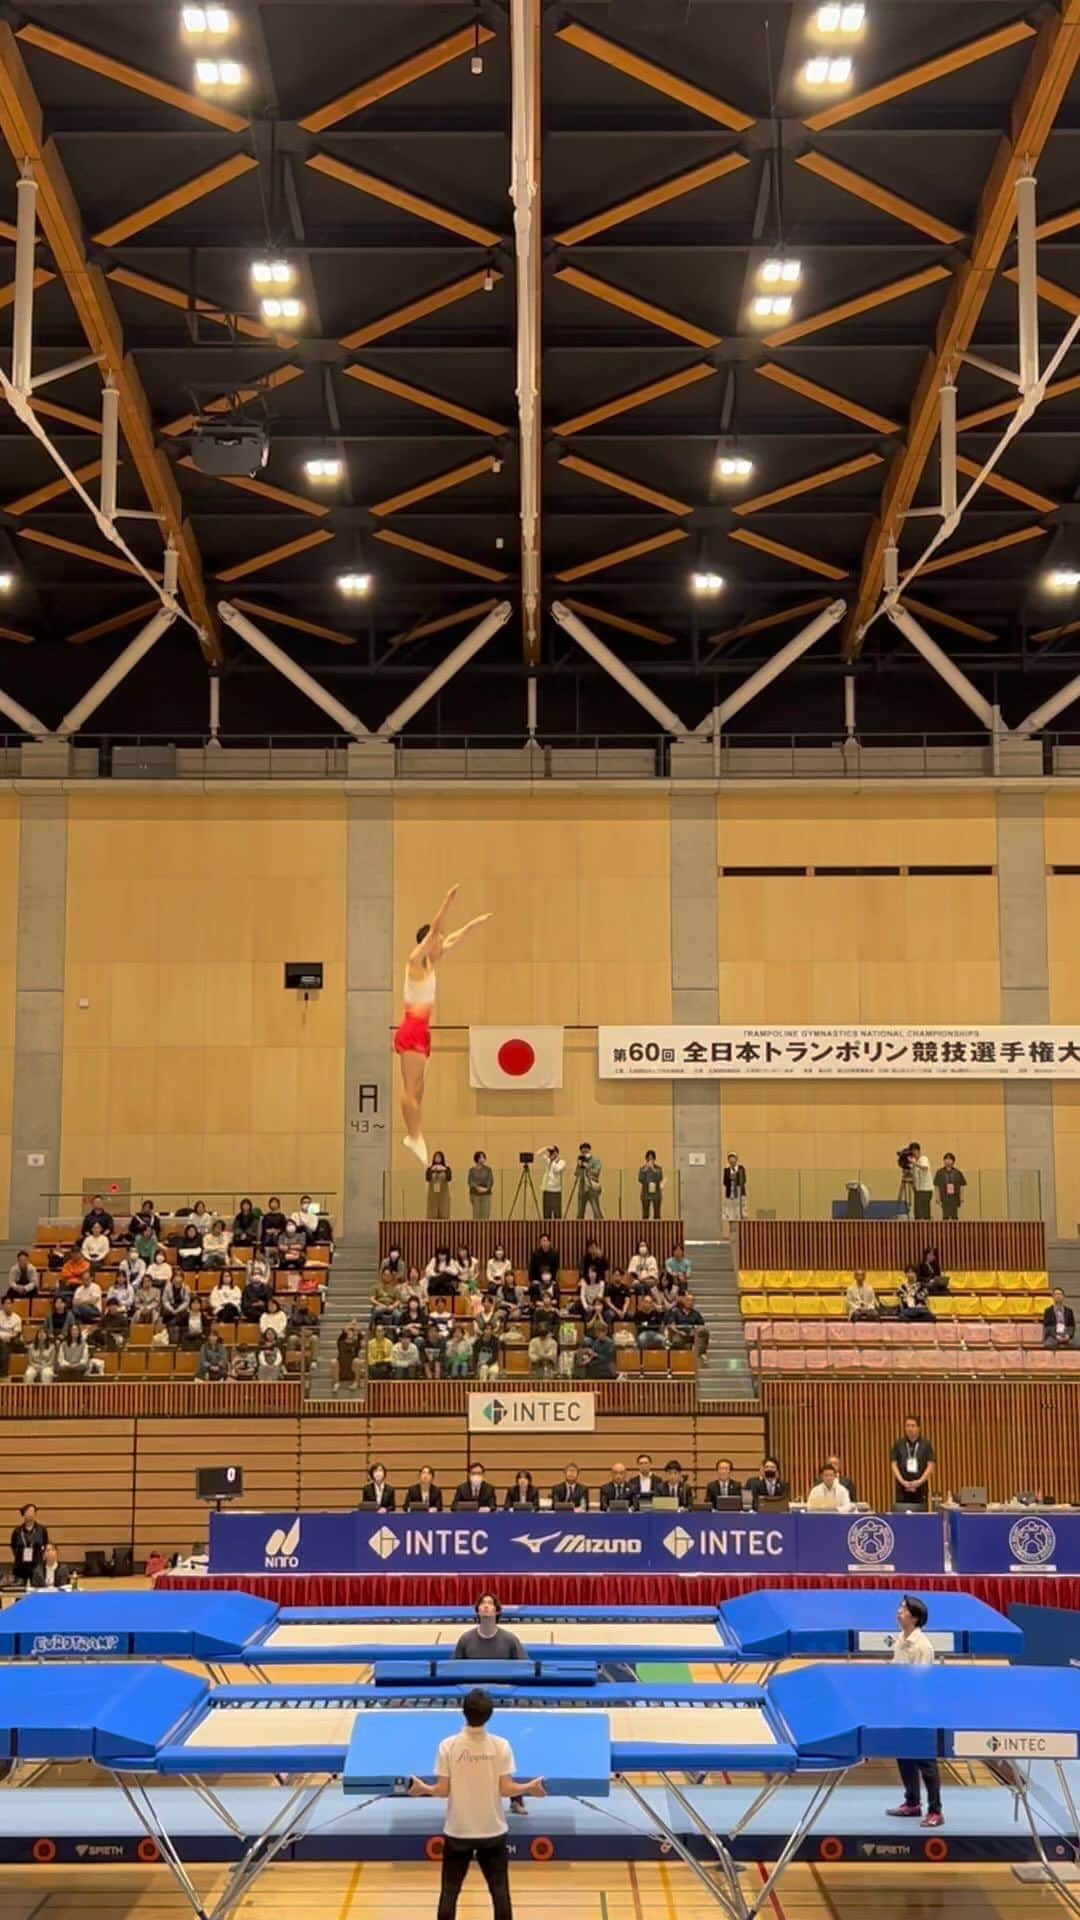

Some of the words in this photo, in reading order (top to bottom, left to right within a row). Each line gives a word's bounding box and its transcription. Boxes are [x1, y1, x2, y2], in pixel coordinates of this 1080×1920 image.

[743, 1030, 798, 1038] TRAMPOLINE
[801, 1030, 858, 1038] GYMNASTICS
[861, 1030, 904, 1038] NATIONAL
[906, 1030, 980, 1038] CHAMPIONSHIPS
[613, 1042, 675, 1063] 第60回
[359, 1084, 378, 1113] A
[513, 1402, 581, 1422] INTEC
[227, 1467, 236, 1482] 0
[405, 1530, 489, 1555] INTEC
[700, 1530, 784, 1556] INTEC
[265, 1556, 299, 1568] NITTO
[1004, 1738, 1046, 1752] INTEC
